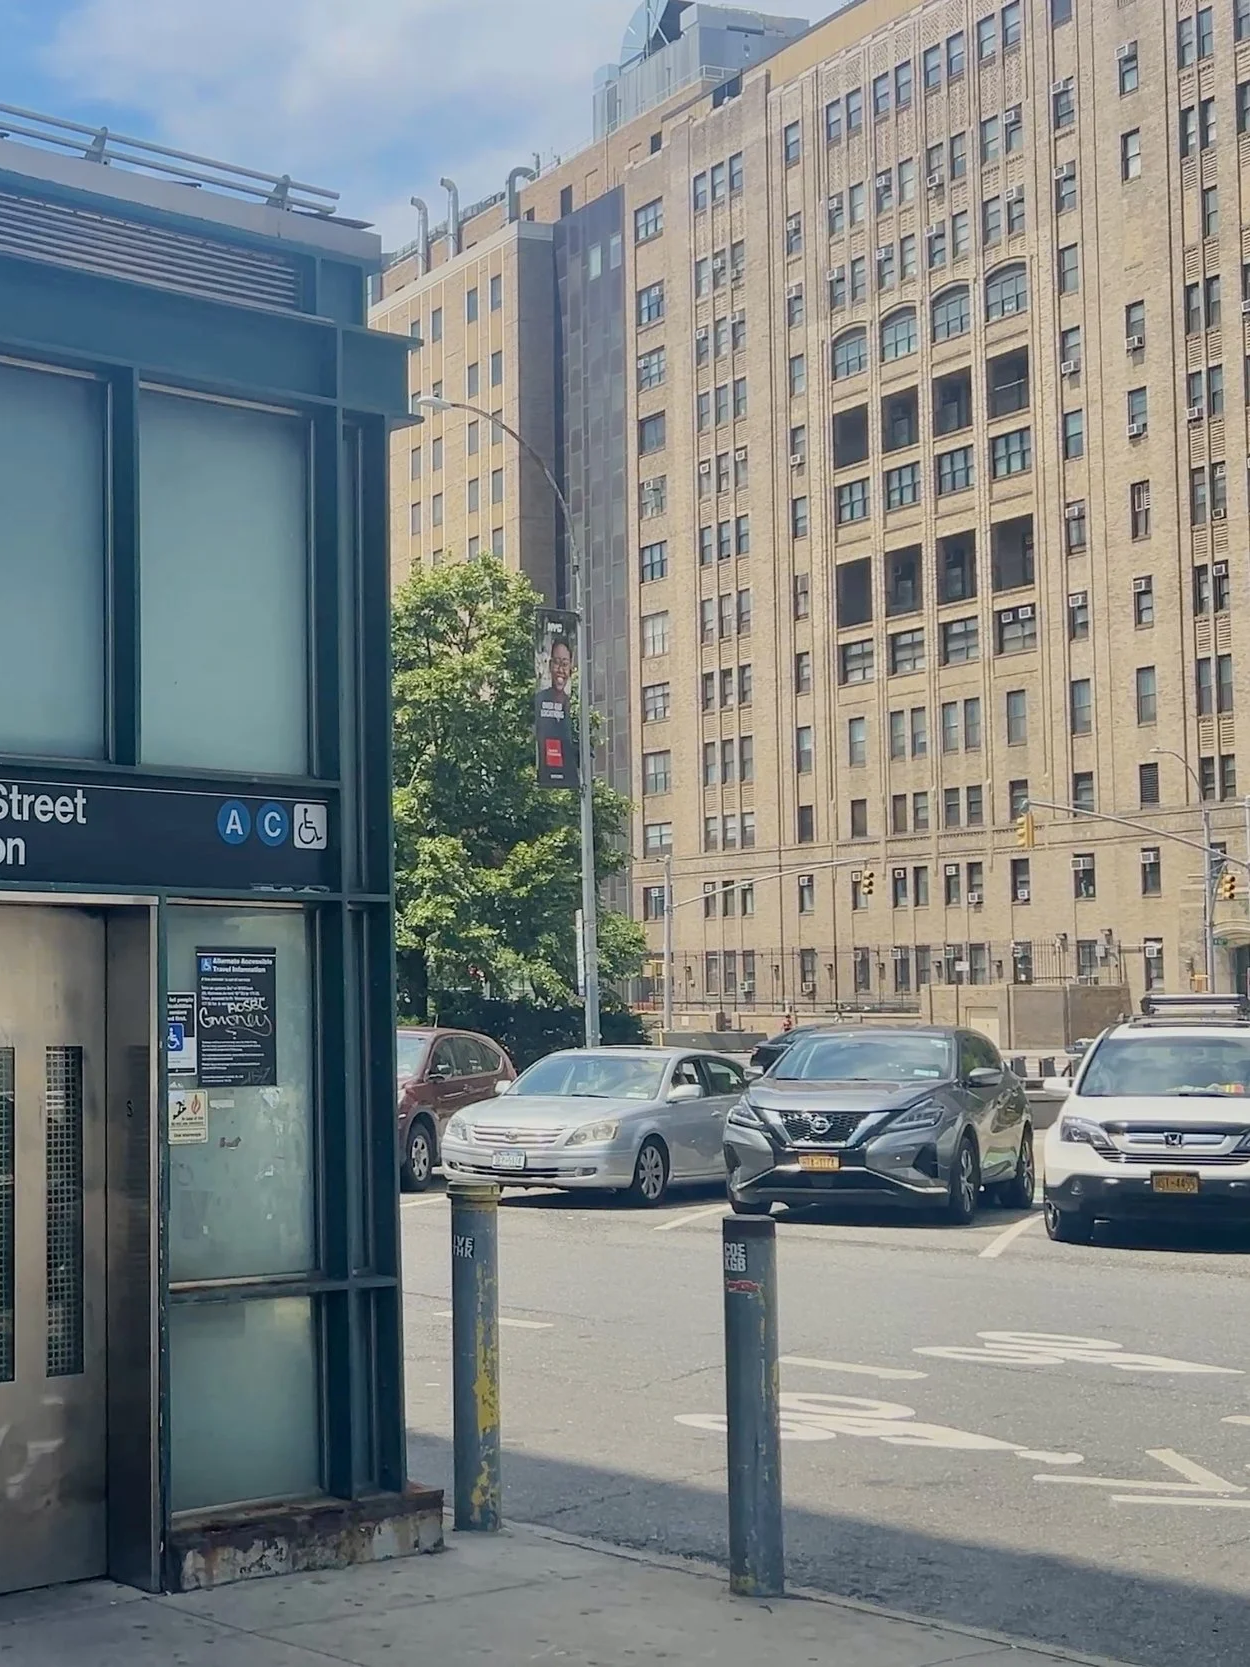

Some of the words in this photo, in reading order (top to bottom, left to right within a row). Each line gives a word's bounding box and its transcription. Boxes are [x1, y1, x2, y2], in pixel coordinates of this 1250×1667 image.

[547, 622, 562, 633] NYC
[225, 809, 244, 836] A
[264, 811, 282, 838] C
